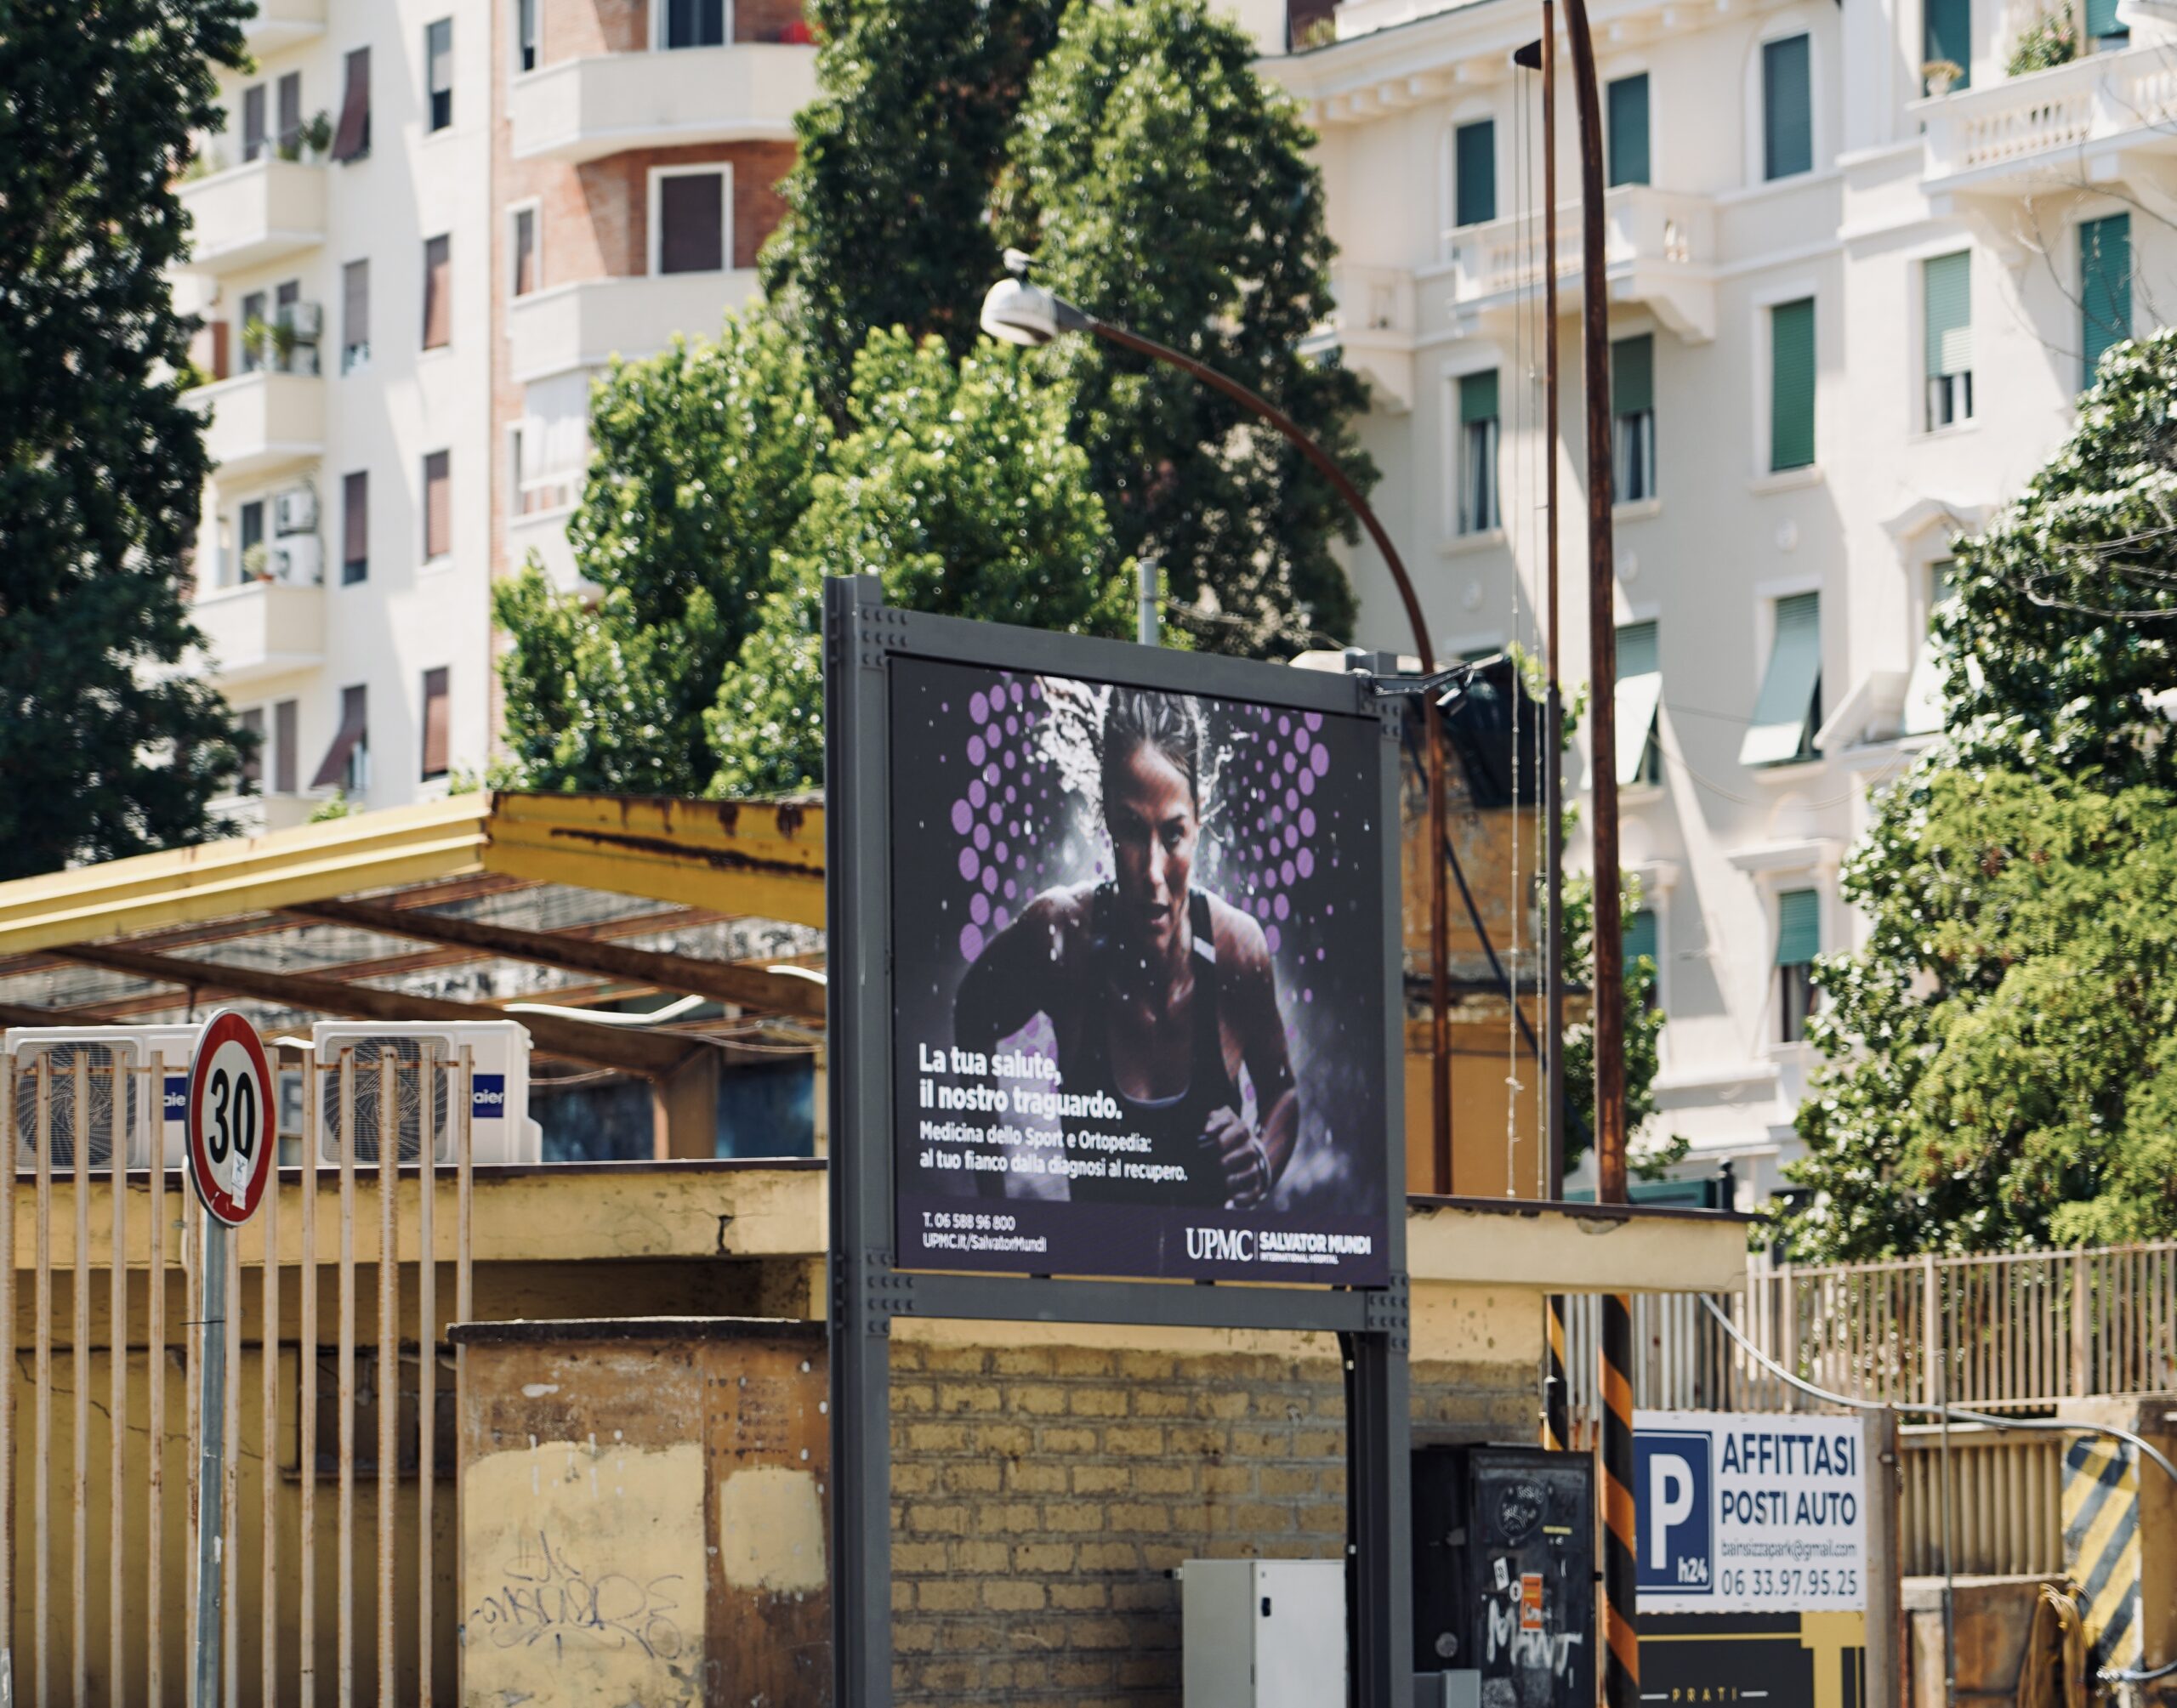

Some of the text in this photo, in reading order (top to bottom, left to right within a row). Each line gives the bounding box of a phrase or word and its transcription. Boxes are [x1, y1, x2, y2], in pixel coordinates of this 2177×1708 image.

[919, 1042, 1062, 1086] La tua salute,
[163, 1092, 186, 1107] aie
[474, 1088, 504, 1104] aier
[919, 1078, 1123, 1121] il nostro traguardo.
[209, 1068, 256, 1164] 30
[919, 1120, 1151, 1154] Medicina dello Sport e Ortopedia:
[919, 1148, 1188, 1183] al tuo fianco dalla diagnosi al recupero.
[922, 1211, 1015, 1232] T. 06 588 96 800
[1185, 1228, 1253, 1262] UPMC
[1259, 1231, 1372, 1255] SALVATOR MUNDI
[1721, 1433, 1856, 1476] AFFITTASI
[1650, 1454, 1694, 1569] P
[1721, 1490, 1856, 1526] POSTI AUTO
[1678, 1556, 1708, 1583] h24
[1721, 1569, 1857, 1596] 06 33.97.95.25
[1672, 1687, 1737, 1703] PRATI
